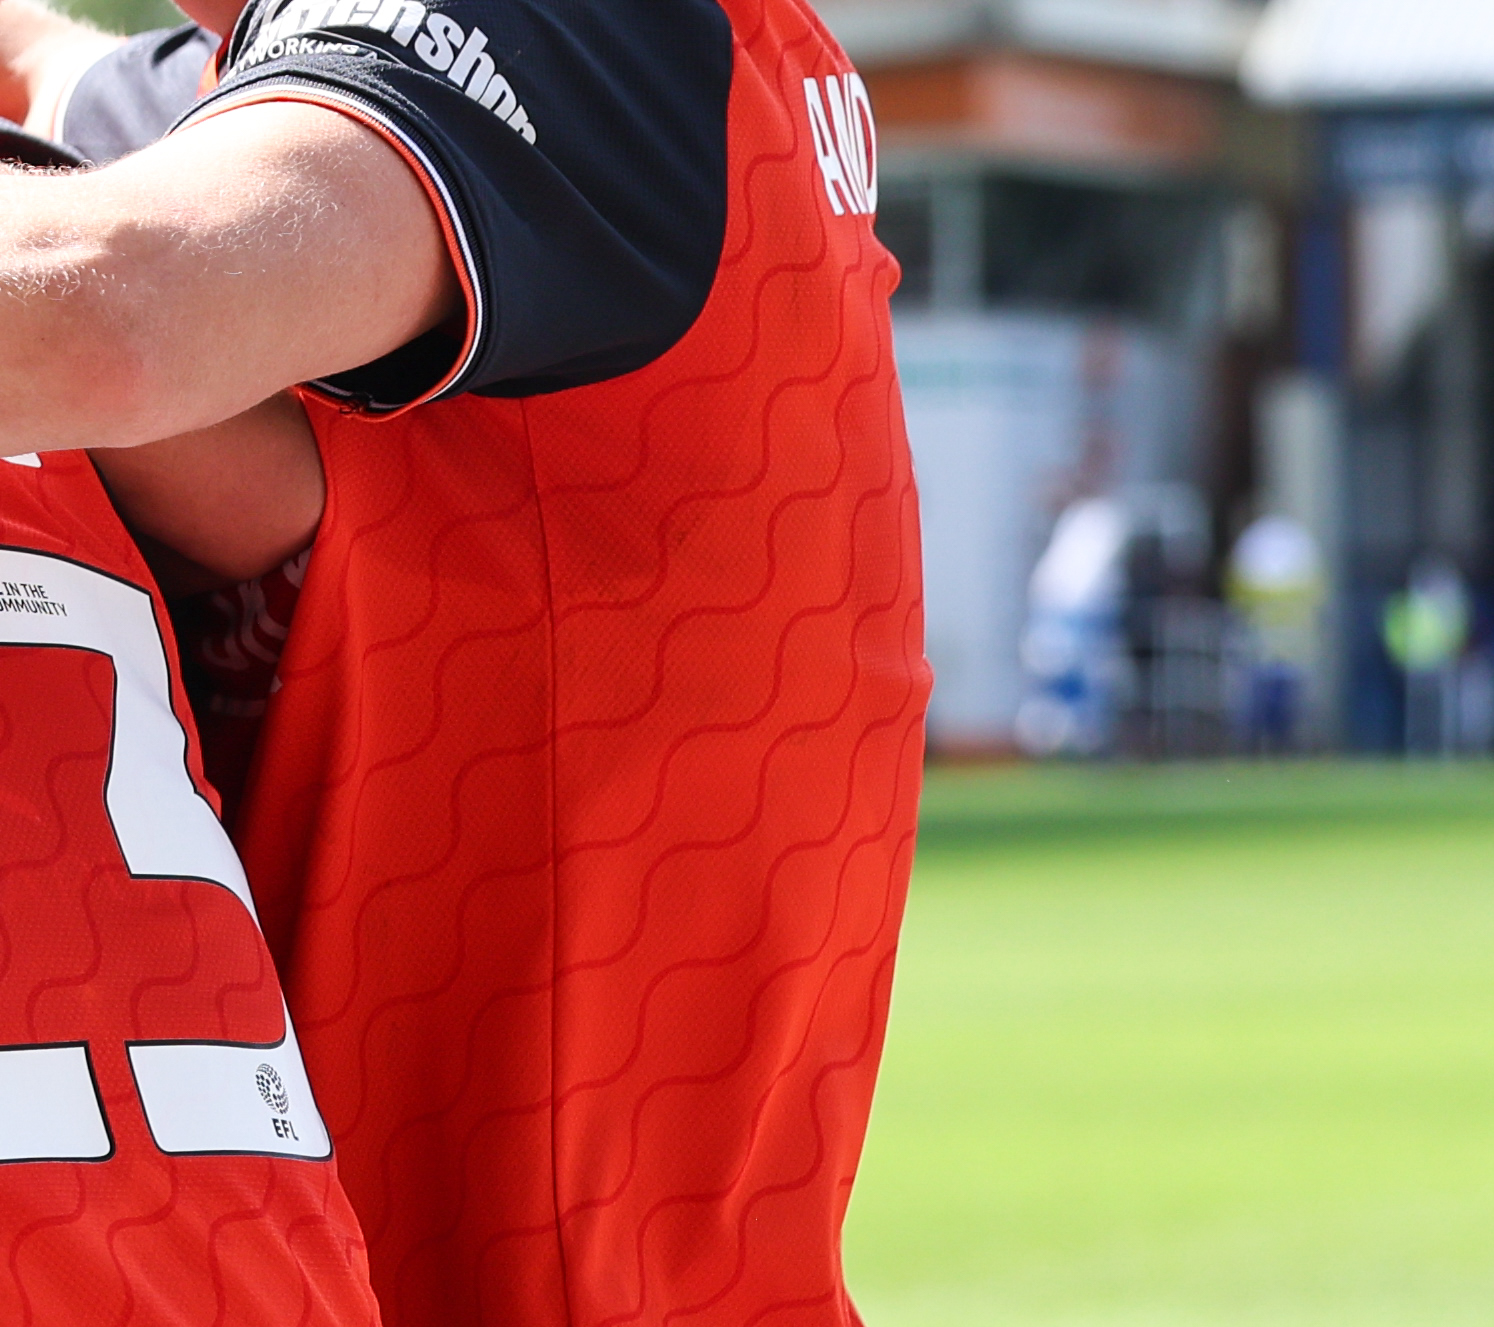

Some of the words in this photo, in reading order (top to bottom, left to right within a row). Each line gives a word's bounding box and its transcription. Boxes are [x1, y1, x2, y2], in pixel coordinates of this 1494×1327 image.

[2, 581, 21, 597] IN
[20, 583, 49, 599] THE
[271, 1117, 300, 1142] EFL
